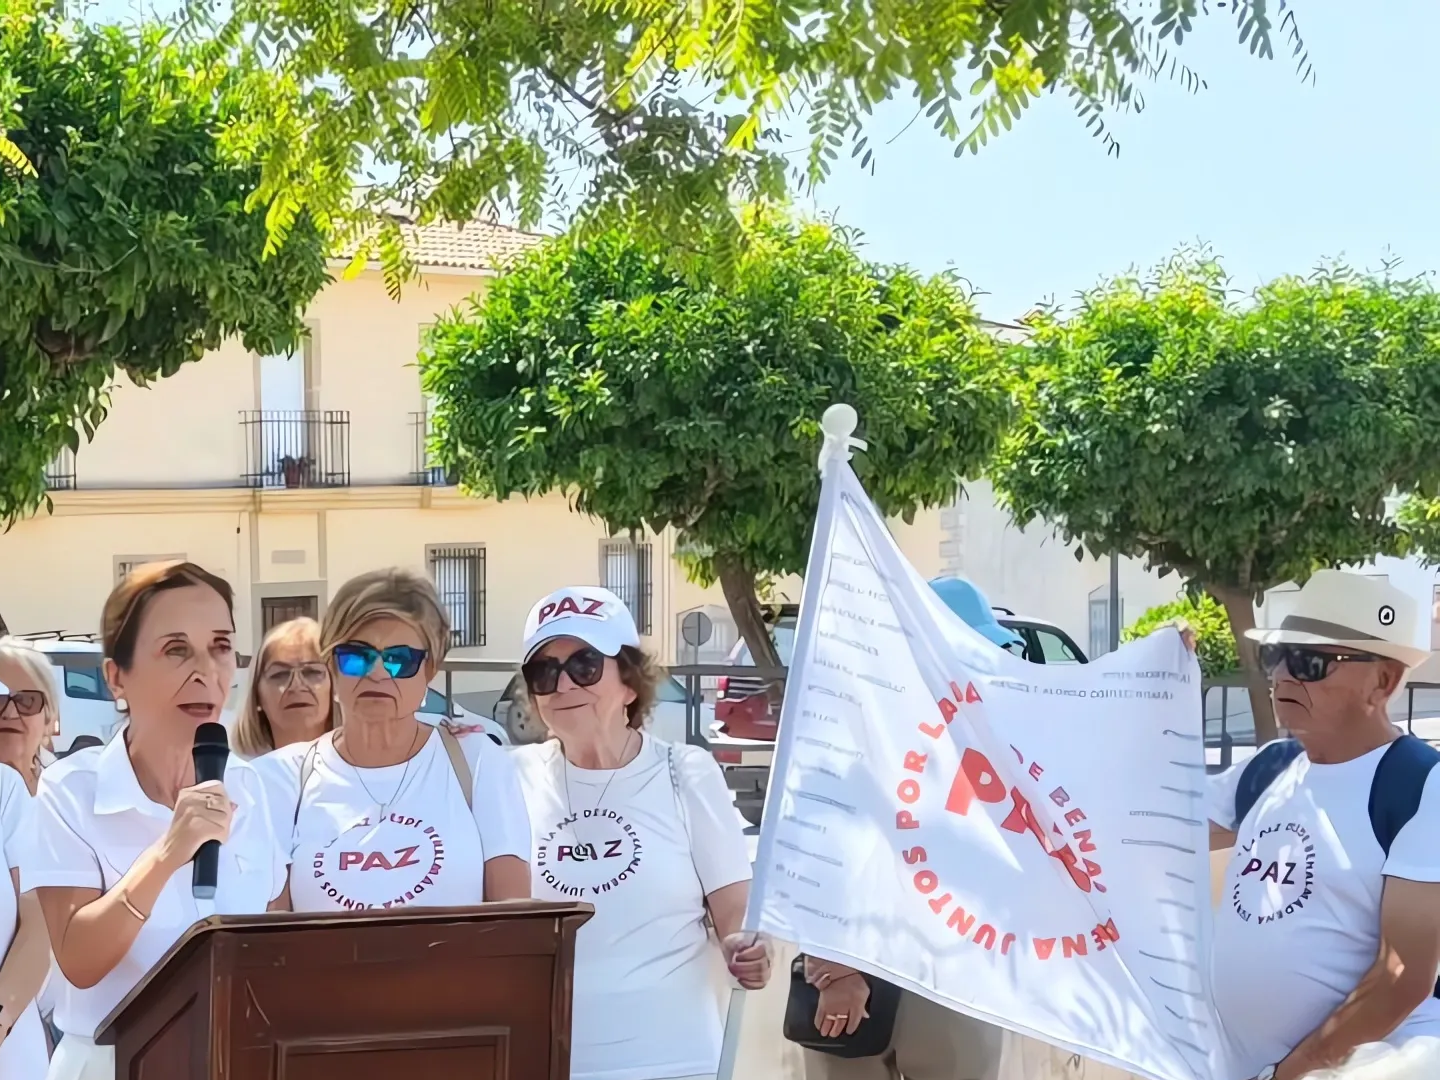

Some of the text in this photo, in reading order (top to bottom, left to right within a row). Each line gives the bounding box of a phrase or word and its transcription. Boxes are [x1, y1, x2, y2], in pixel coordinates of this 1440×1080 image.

[538, 596, 606, 625] PAZ
[896, 697, 1016, 956] JUNTOS POR LA
[338, 844, 421, 872] PAZ
[1240, 857, 1297, 885] PAZ
